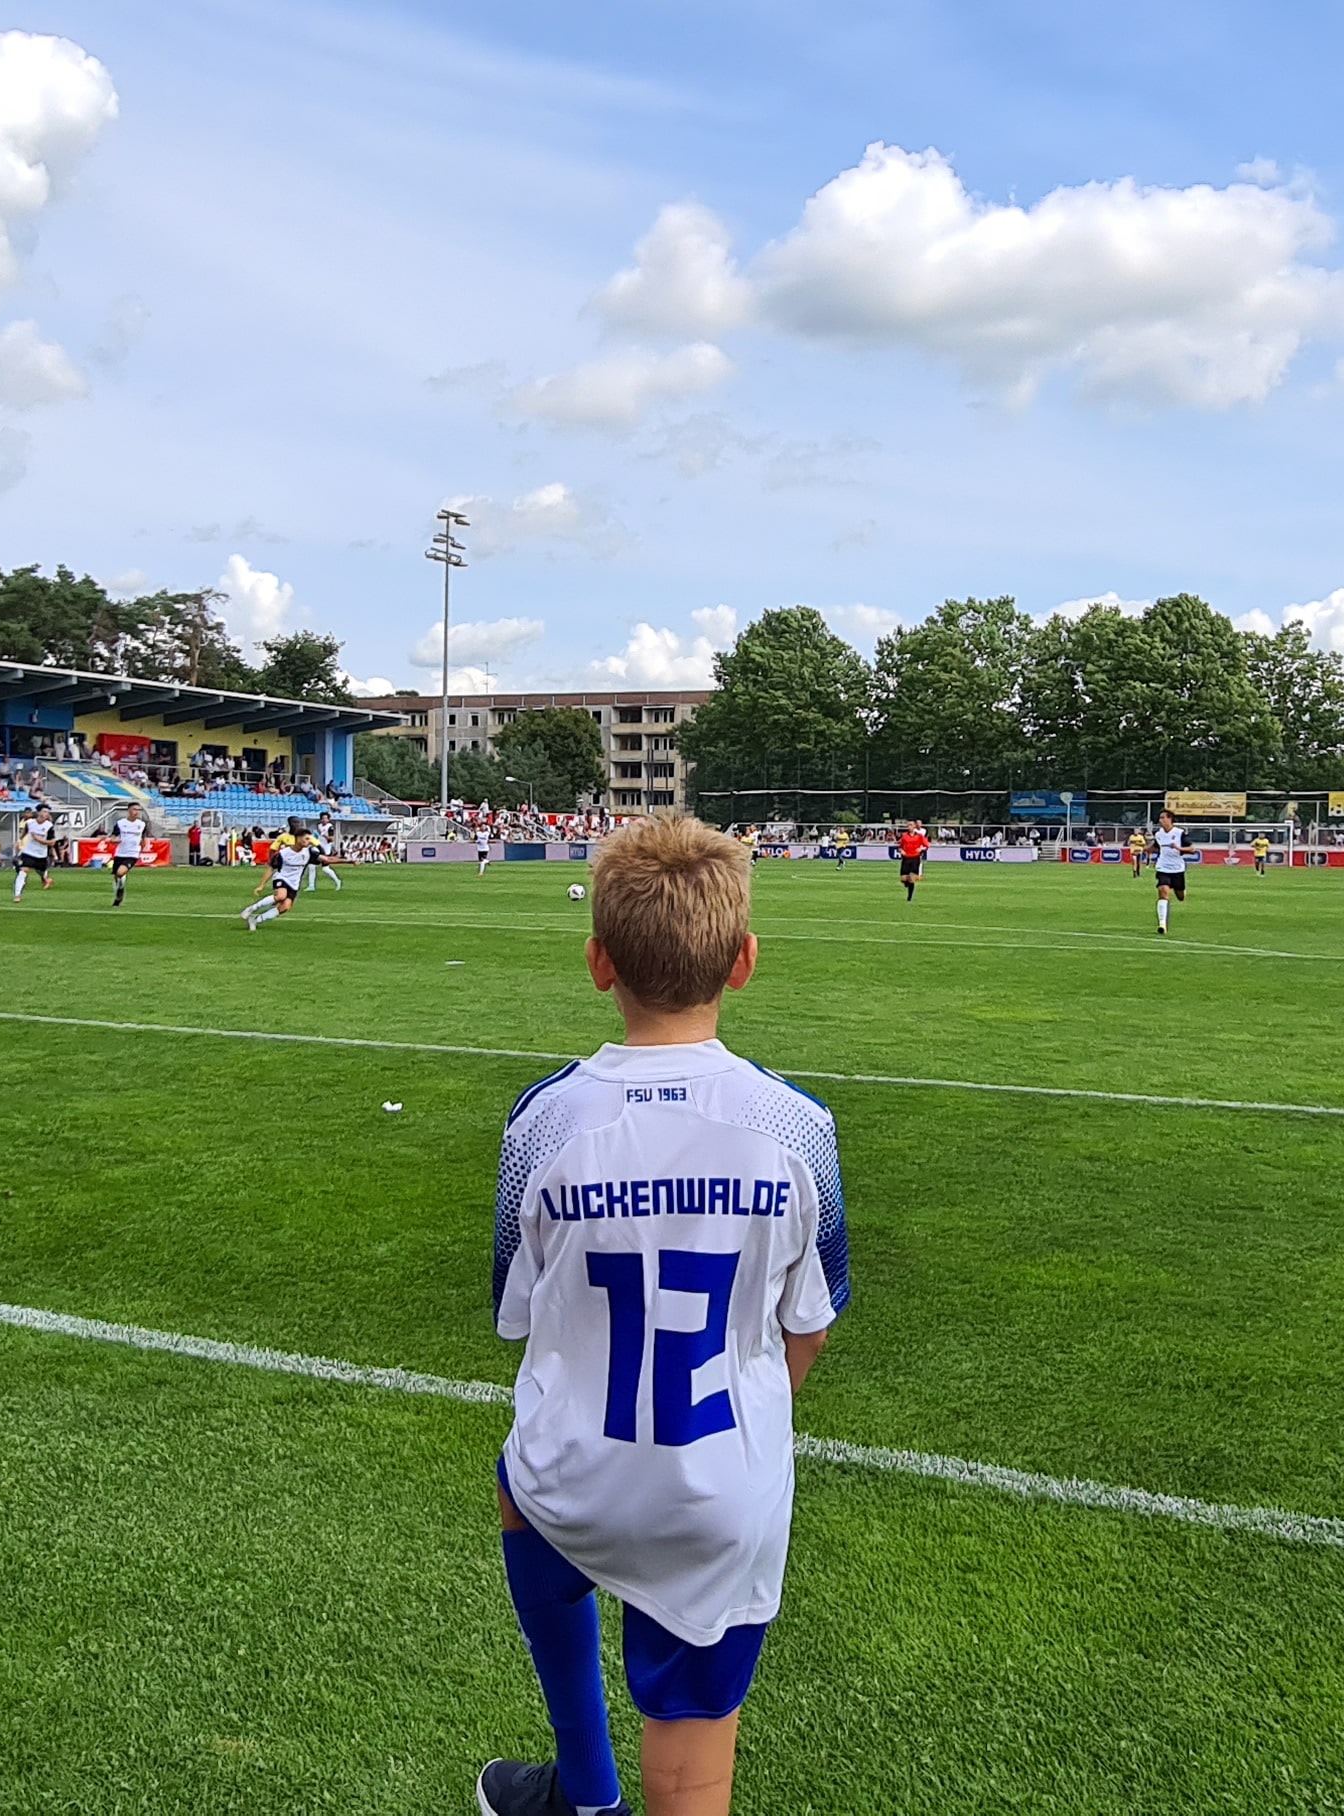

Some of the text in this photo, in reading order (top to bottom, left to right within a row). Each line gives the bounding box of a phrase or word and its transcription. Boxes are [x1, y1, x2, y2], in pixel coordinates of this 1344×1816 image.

[825, 849, 852, 858] HYO
[965, 850, 994, 860] HYLO
[657, 1087, 687, 1101] 1963
[541, 1178, 791, 1221] LUCKENWALDE
[585, 1248, 742, 1447] 12
